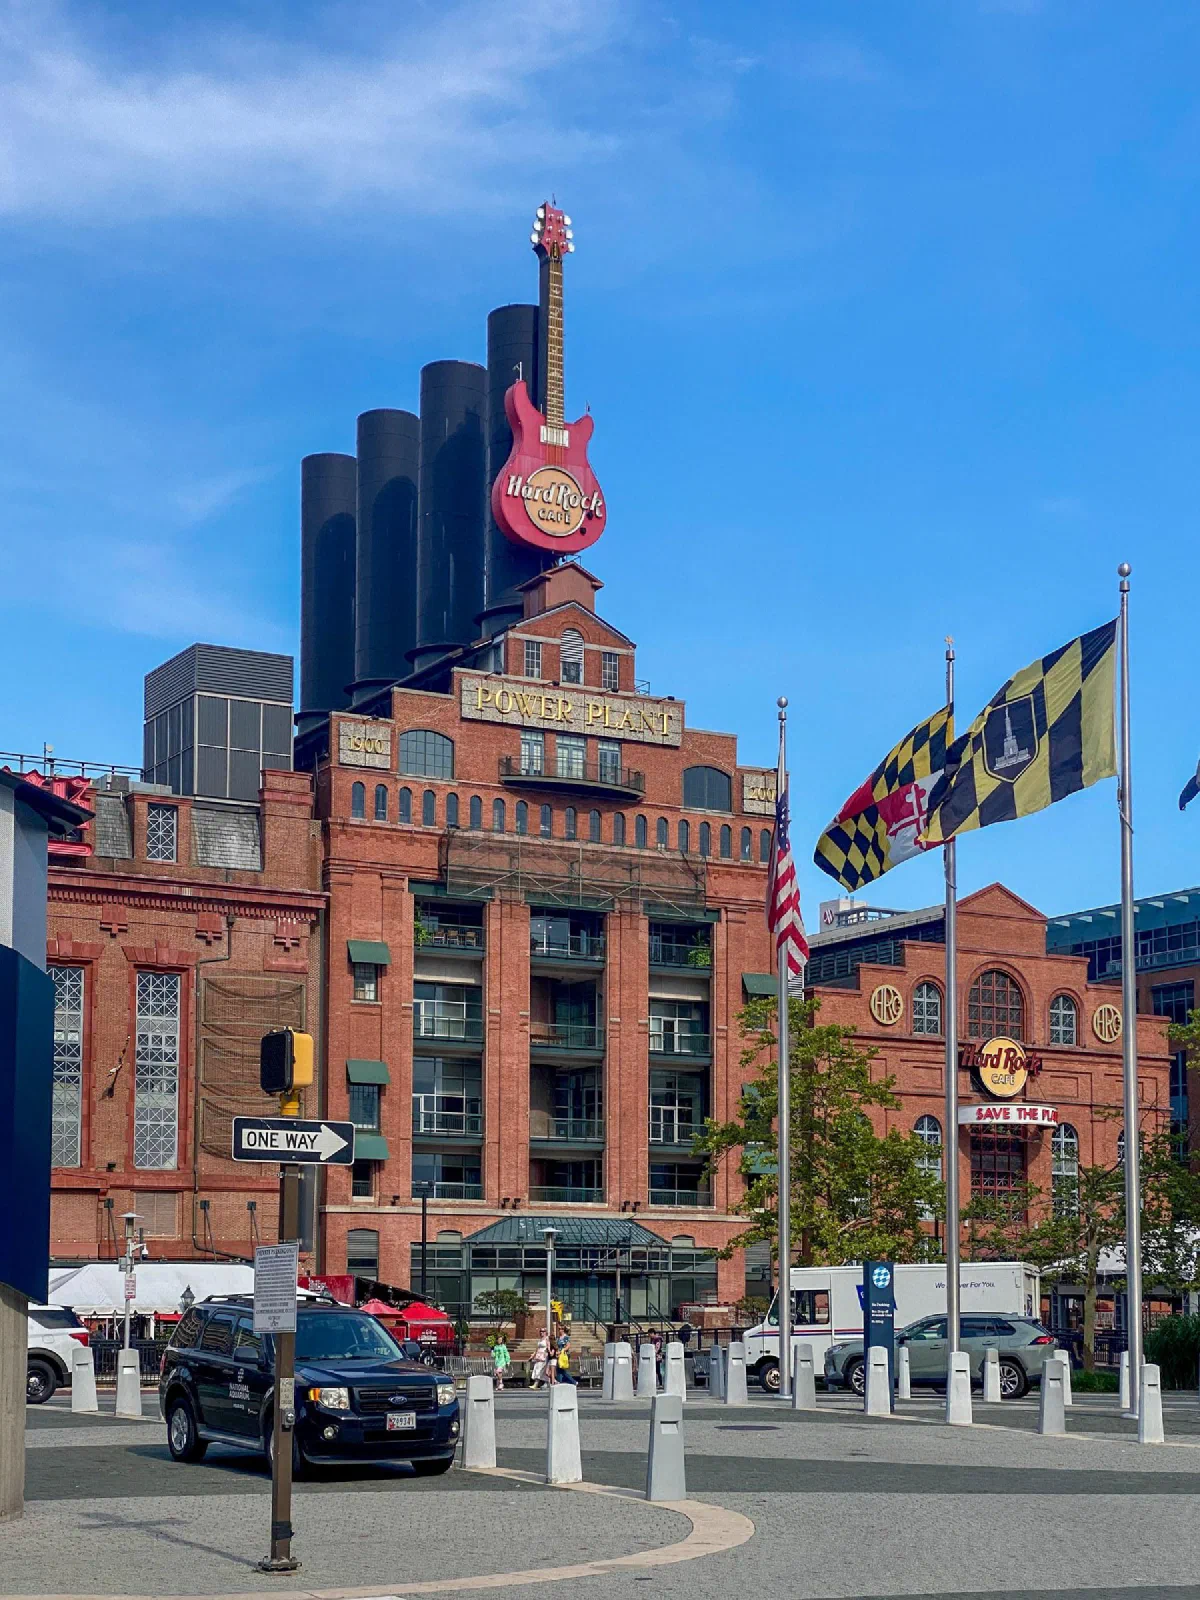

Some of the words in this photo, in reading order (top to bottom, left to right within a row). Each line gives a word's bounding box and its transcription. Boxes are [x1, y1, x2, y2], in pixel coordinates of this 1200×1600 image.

[505, 475, 555, 504] Hard
[556, 483, 604, 518] Rock
[538, 508, 571, 525] CAFE
[475, 686, 574, 724] POWER
[585, 702, 673, 736] PLANT
[348, 735, 384, 754] 1900
[749, 786, 776, 802] 200
[961, 1044, 1003, 1069] Hard
[1003, 1047, 1041, 1077] Rock
[991, 1073, 1015, 1085] CAFE
[976, 1107, 1011, 1121] SAVE
[1016, 1107, 1039, 1121] THE
[247, 1131, 279, 1148] ONE
[286, 1133, 318, 1150] WAY
[229, 1382, 250, 1393] NATIONAL
[229, 1390, 250, 1401] AQUARIUM
